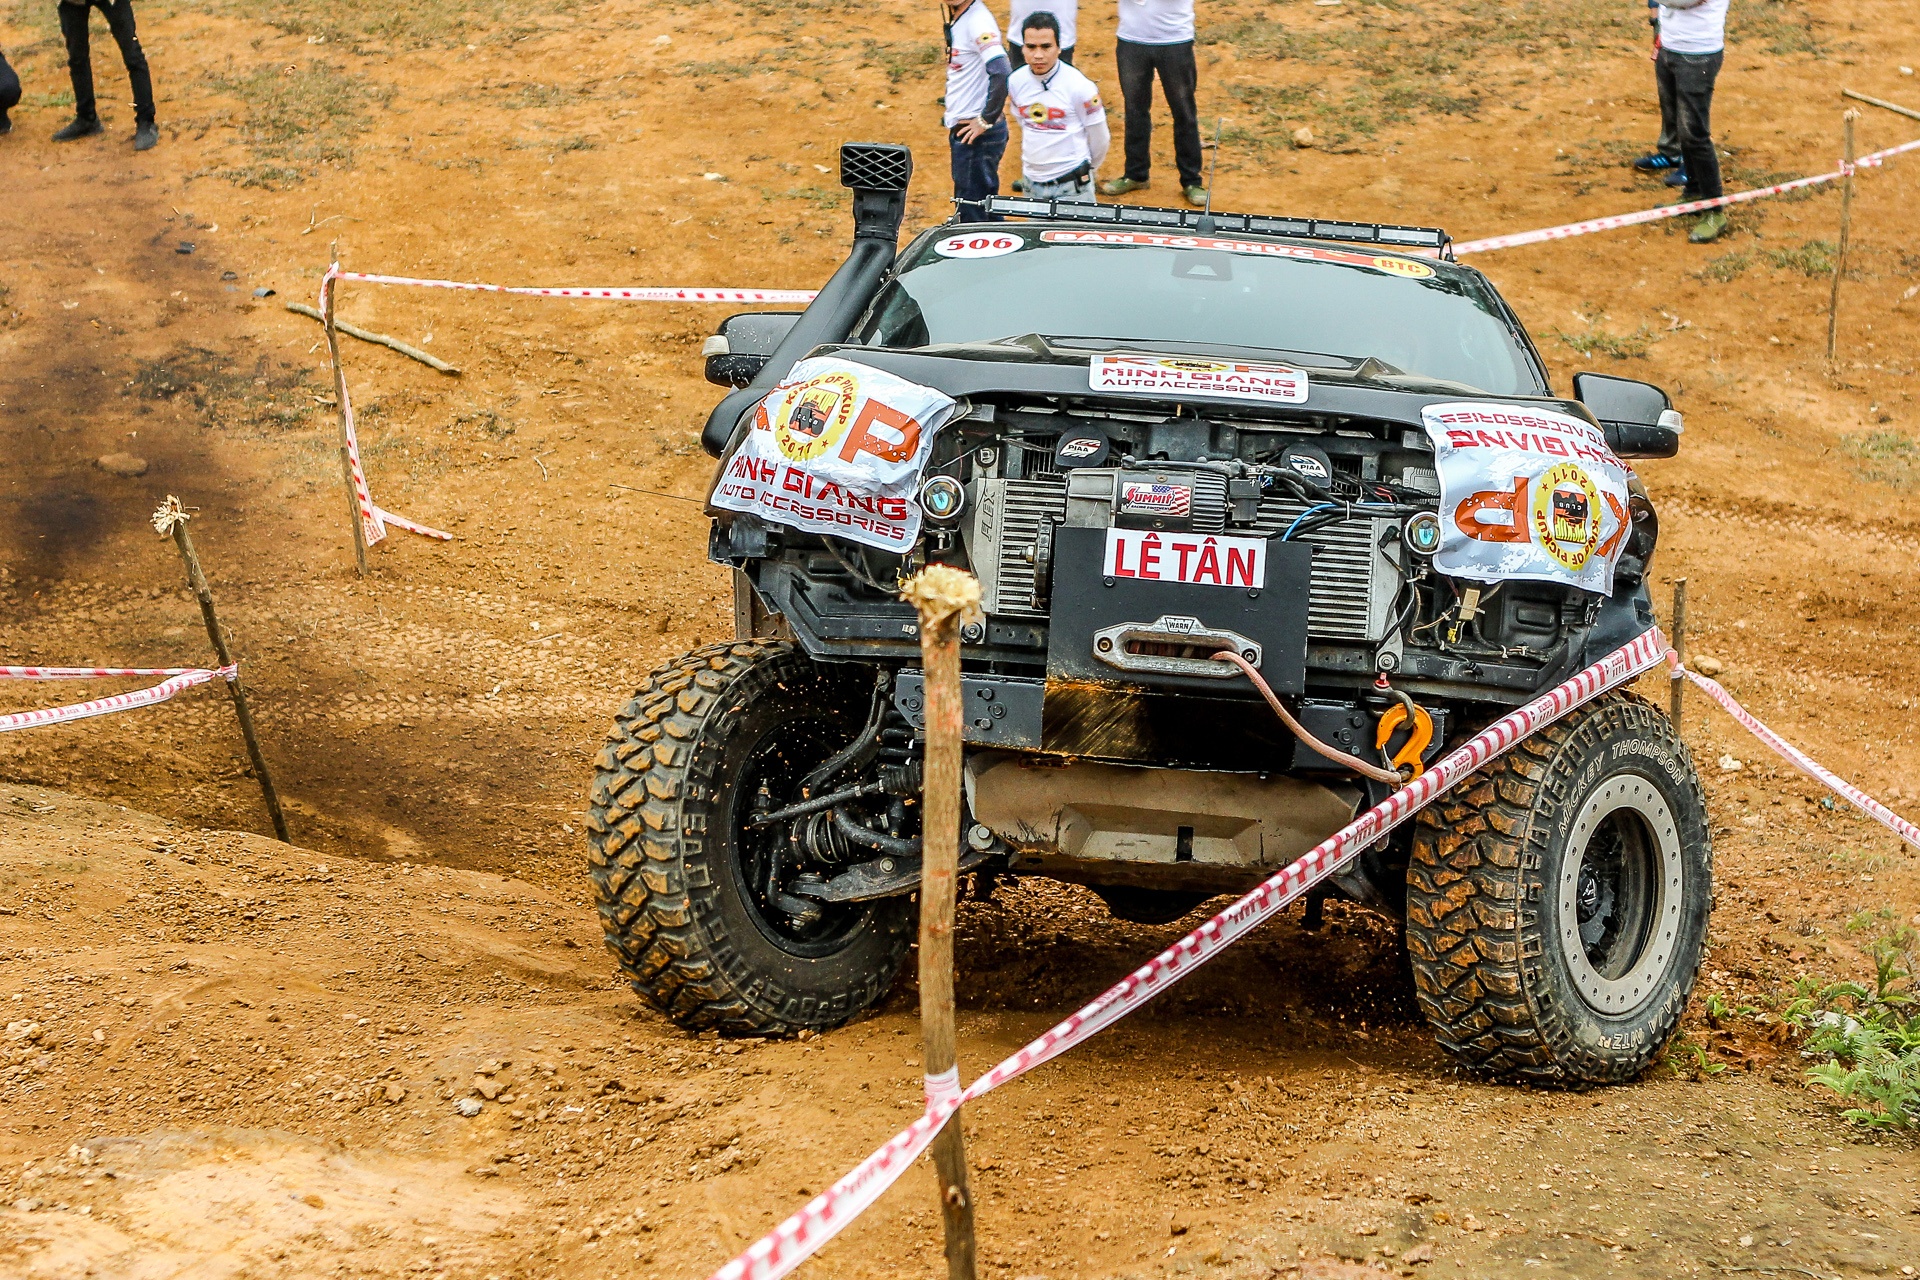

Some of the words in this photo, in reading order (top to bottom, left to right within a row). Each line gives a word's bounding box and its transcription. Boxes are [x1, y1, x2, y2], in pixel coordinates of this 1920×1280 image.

[947, 238, 1012, 250] 506
[1054, 233, 1134, 242] BAN
[1381, 259, 1421, 274] BTC
[1102, 368, 1182, 379] MINH
[1191, 373, 1296, 388] GIANG
[1160, 381, 1296, 397] ACCESSORIES
[825, 375, 844, 384] OF
[838, 379, 854, 425] PICKUP
[1440, 412, 1584, 437] ACCESSORIES
[1068, 444, 1089, 453] PIAA
[1446, 430, 1571, 457] GIANG
[1300, 463, 1322, 472] PIAA
[1553, 468, 1587, 489] 2017
[719, 483, 755, 500] AUTO
[783, 466, 908, 522] GIANG
[1536, 510, 1568, 563] PICKUP
[1113, 532, 1162, 580] LÊ
[1171, 537, 1256, 587] TÂN
[1572, 552, 1585, 565] OF
[1169, 621, 1189, 630] WARN
[1558, 751, 1605, 838] MICKEY
[1611, 738, 1685, 786] THOMPSON
[1647, 981, 1680, 1035] BAJA
